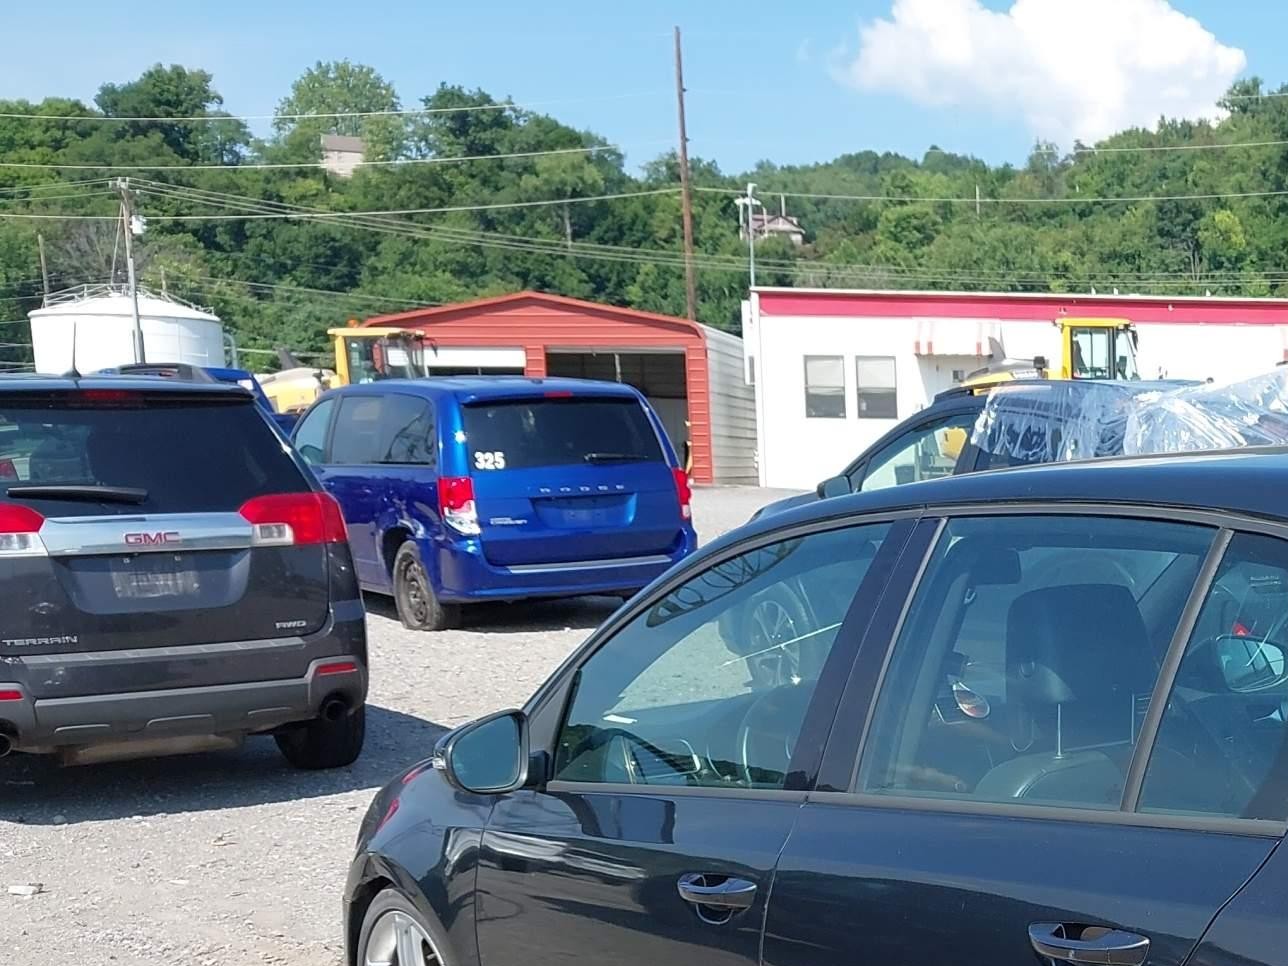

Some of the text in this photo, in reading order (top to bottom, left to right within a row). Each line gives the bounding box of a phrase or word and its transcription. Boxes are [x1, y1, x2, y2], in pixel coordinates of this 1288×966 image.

[474, 451, 506, 470] 325
[124, 531, 181, 545] GMC
[275, 620, 307, 629] AWD
[1, 635, 79, 647] TERRAIN
